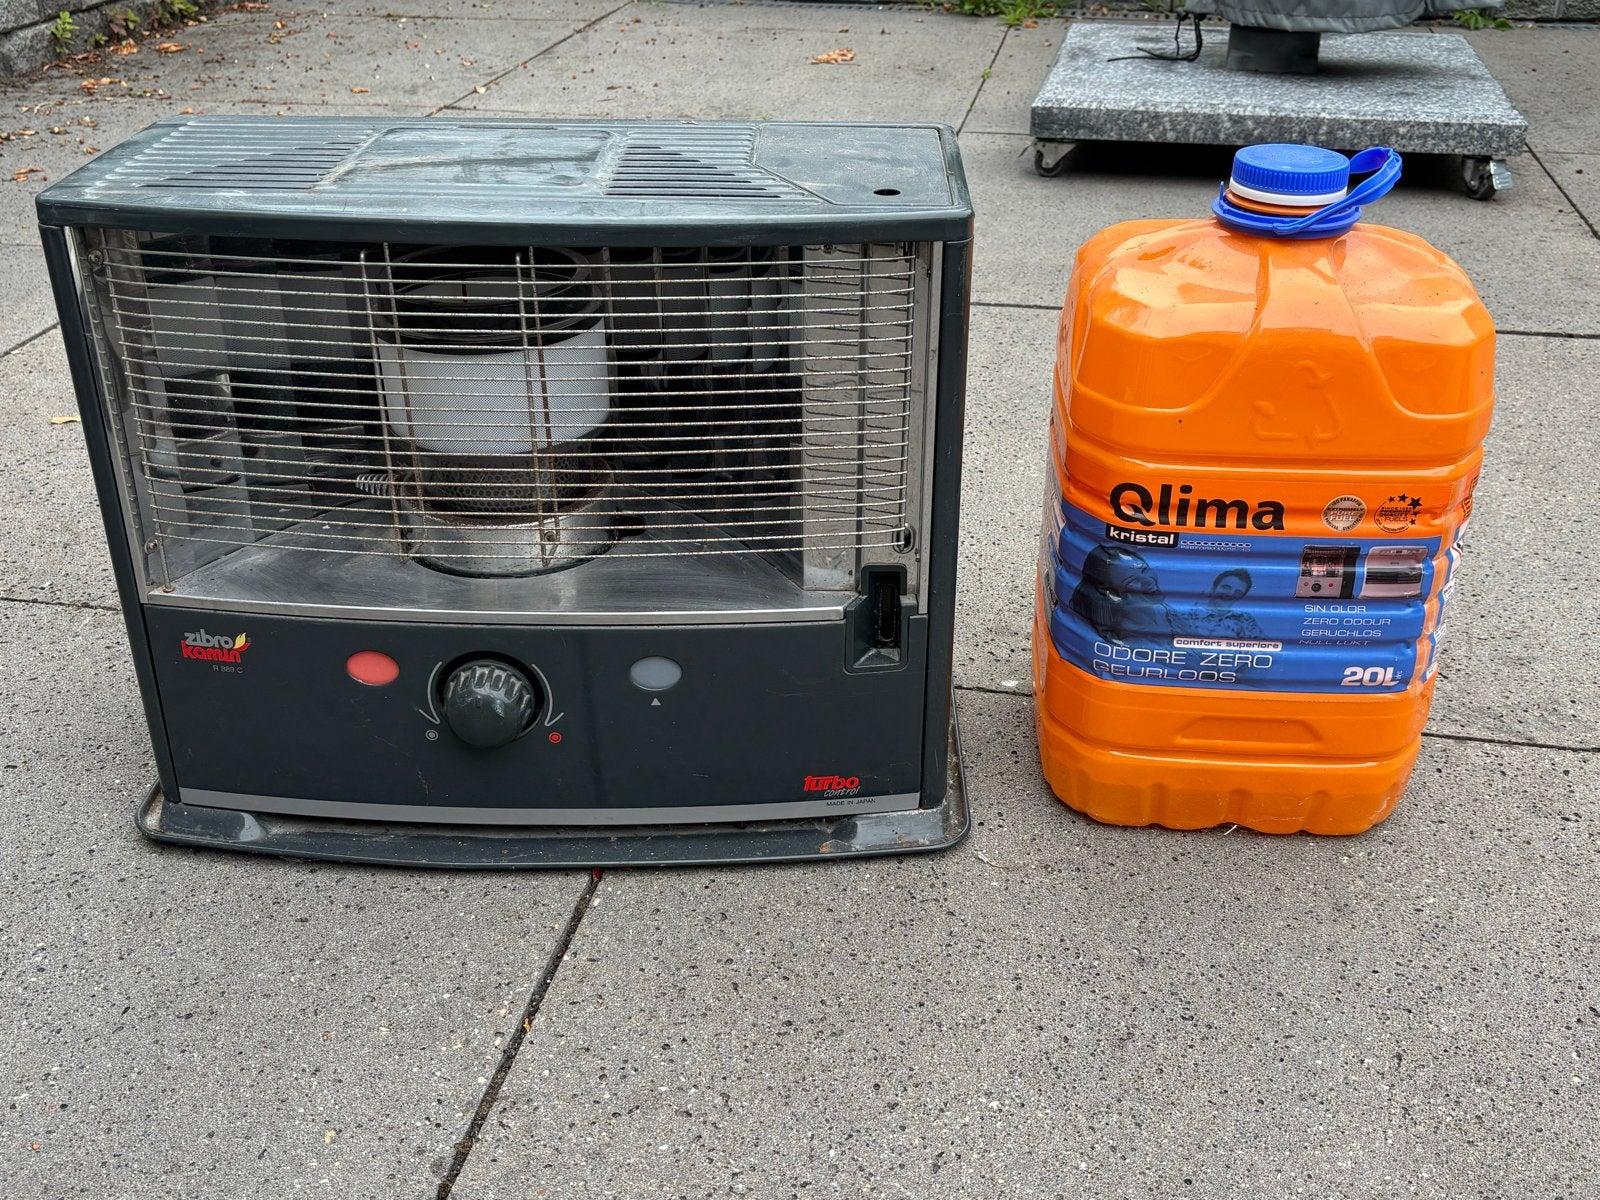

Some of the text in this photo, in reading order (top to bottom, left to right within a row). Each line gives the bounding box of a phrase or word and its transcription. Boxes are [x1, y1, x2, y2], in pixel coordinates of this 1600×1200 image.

[1110, 482, 1285, 531] Qlima
[1109, 526, 1175, 545] kristal
[1304, 604, 1366, 613] SIN OLOR
[1303, 617, 1391, 626] ZERO ODOUR
[184, 628, 233, 649] zibro
[1301, 629, 1381, 637] GERUCHLOS
[181, 640, 241, 663] kamin
[1176, 638, 1279, 650] comfort superiore
[1094, 641, 1272, 669] ODORE ZERO
[1093, 659, 1236, 683] GEURLOOS
[1340, 666, 1399, 686] 20L
[803, 775, 859, 792] turbo
[823, 785, 861, 798] control
